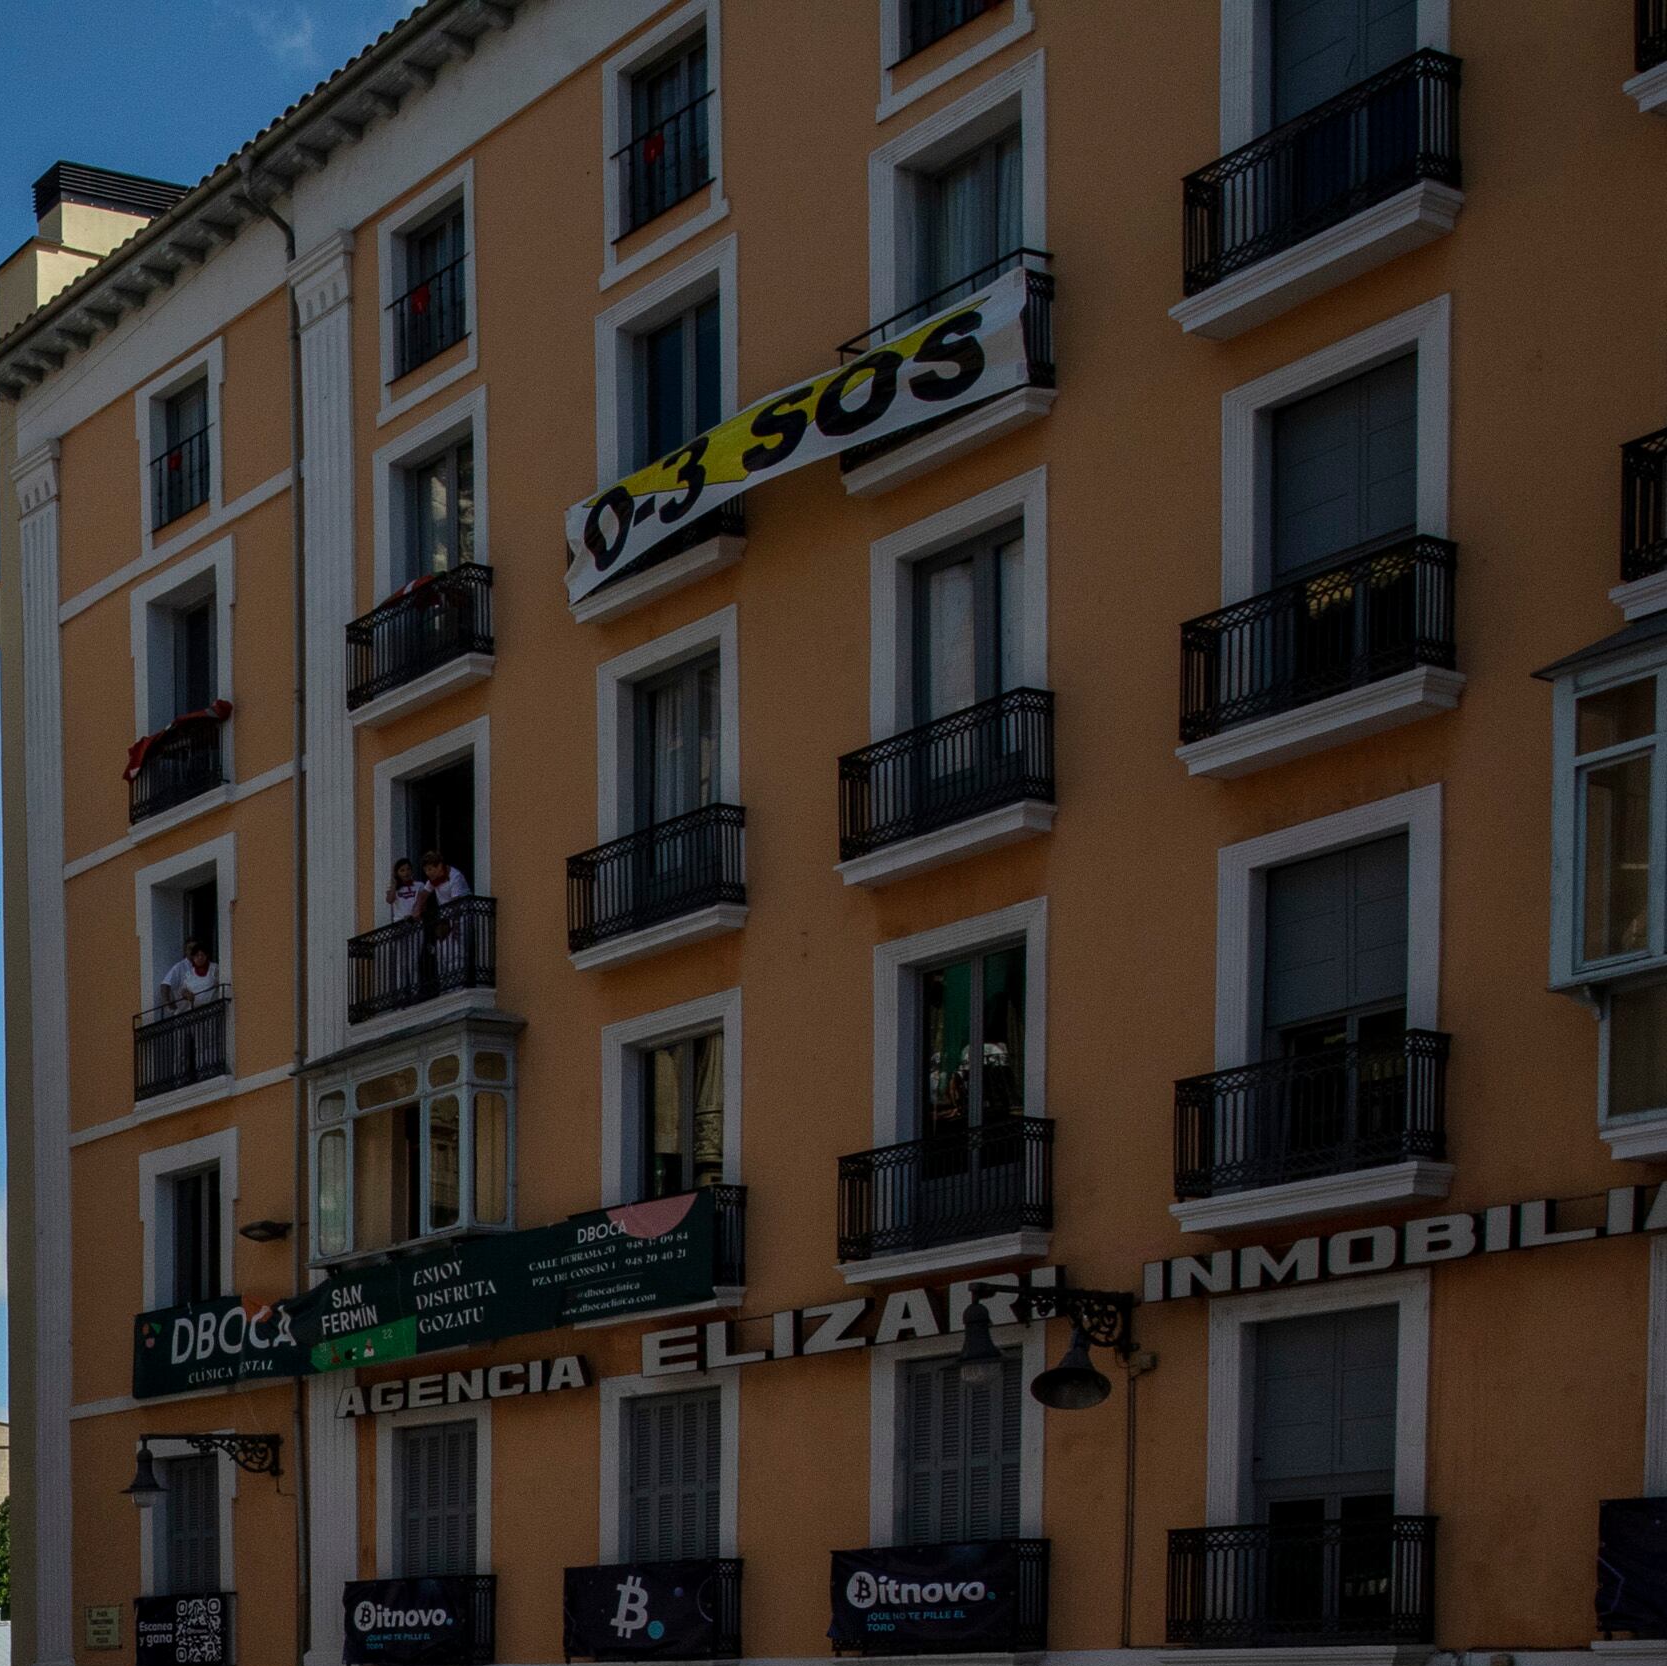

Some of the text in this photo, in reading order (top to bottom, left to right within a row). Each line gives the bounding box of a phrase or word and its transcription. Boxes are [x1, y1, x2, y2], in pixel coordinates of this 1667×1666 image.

[584, 310, 986, 572] 0-3 SOS
[576, 1219, 627, 1245] DBOCA
[412, 1259, 464, 1288] ENJOY
[331, 1284, 363, 1310] SAN
[416, 1278, 498, 1311] DISFRUTA
[321, 1302, 379, 1336] FERMÍN
[418, 1306, 485, 1336] GOZATU
[171, 1304, 298, 1366] DBOCA
[336, 1265, 1058, 1419] AGENCIA ELIZARI
[138, 1621, 173, 1632] Escanea
[138, 1633, 173, 1648] y gana
[866, 1622, 897, 1633] TORO
